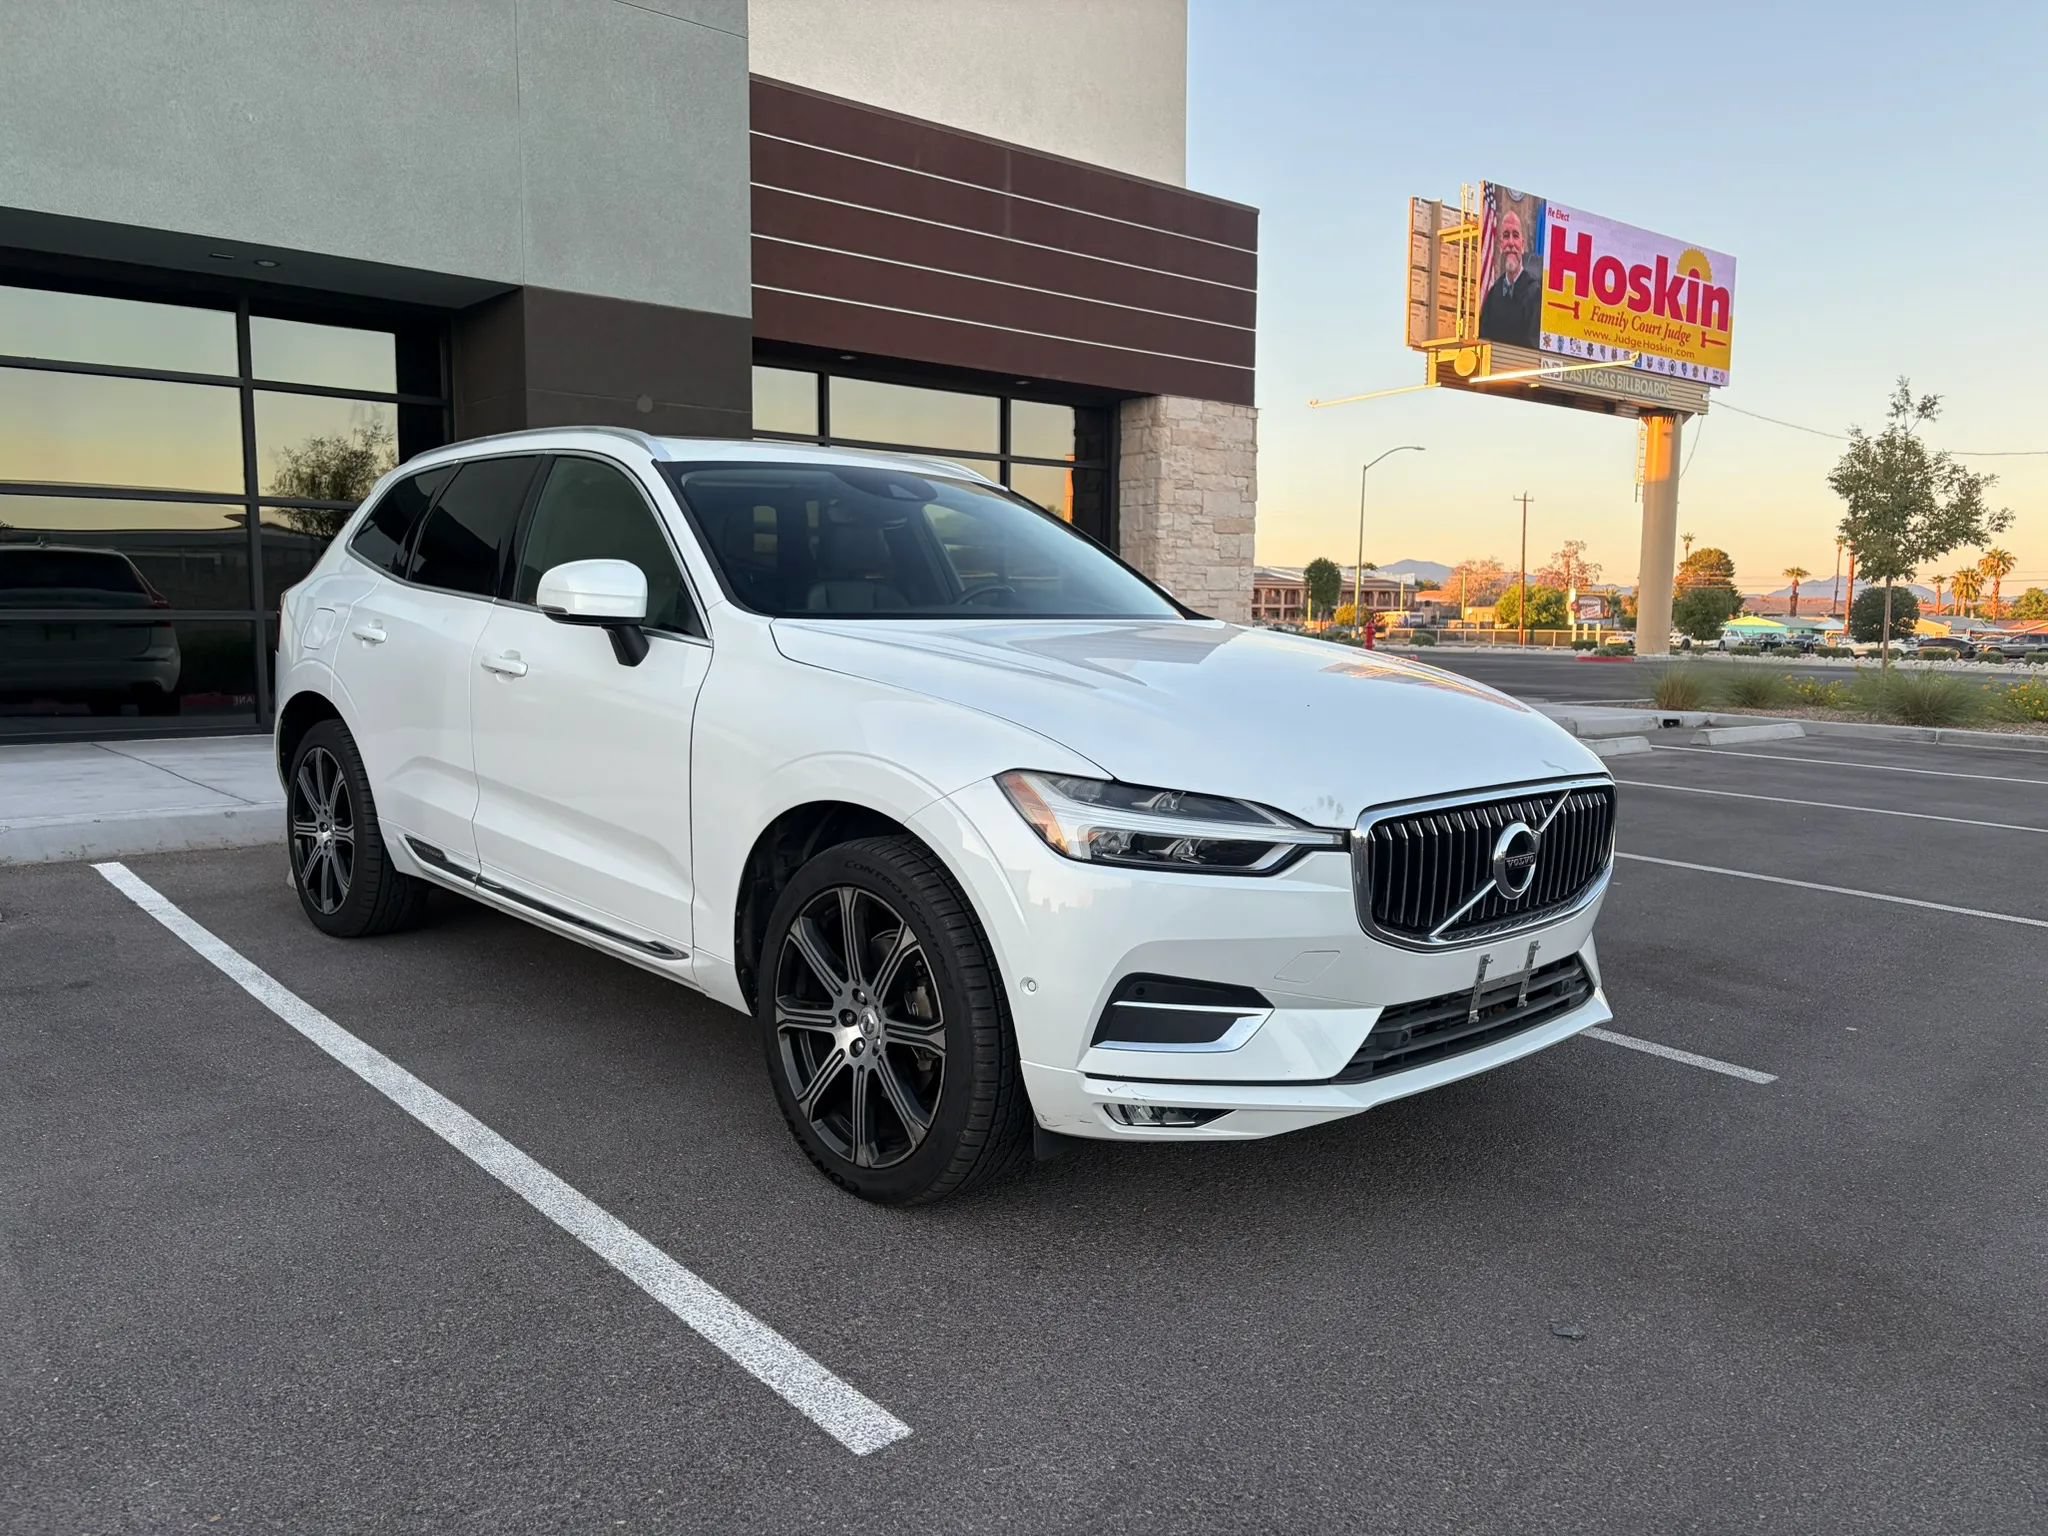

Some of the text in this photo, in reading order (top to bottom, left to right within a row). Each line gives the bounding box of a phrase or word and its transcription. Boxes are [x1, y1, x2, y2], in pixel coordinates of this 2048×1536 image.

[1548, 207, 1569, 221] Re Elect
[1548, 224, 1730, 332] Hoskin
[1590, 306, 1691, 347] Family Court Judge
[1564, 370, 1672, 398] LAS VEGAS BILLBOARDS
[1506, 855, 1534, 868] VOLVO
